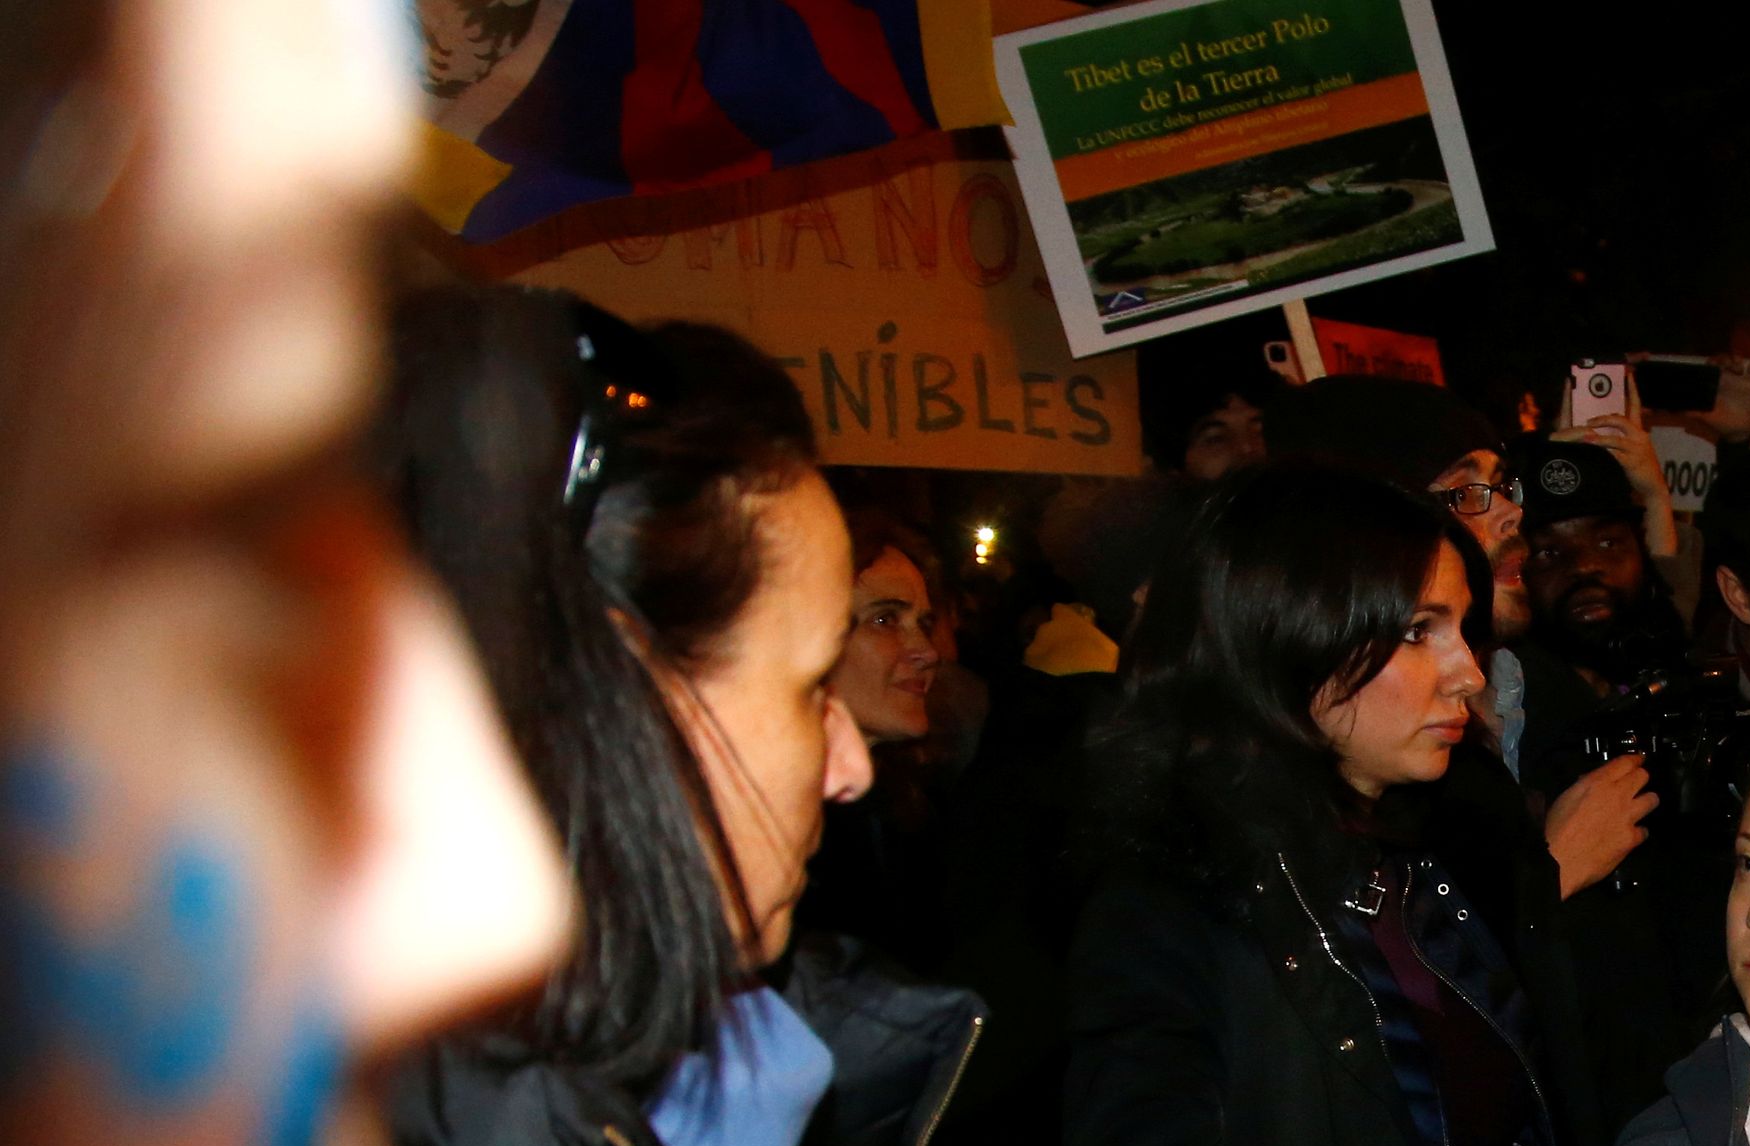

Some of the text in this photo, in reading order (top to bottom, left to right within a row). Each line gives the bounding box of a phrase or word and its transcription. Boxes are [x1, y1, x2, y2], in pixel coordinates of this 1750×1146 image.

[1066, 13, 1330, 92] Tibet es el tercer Polo
[1141, 65, 1279, 111] de la Tierra
